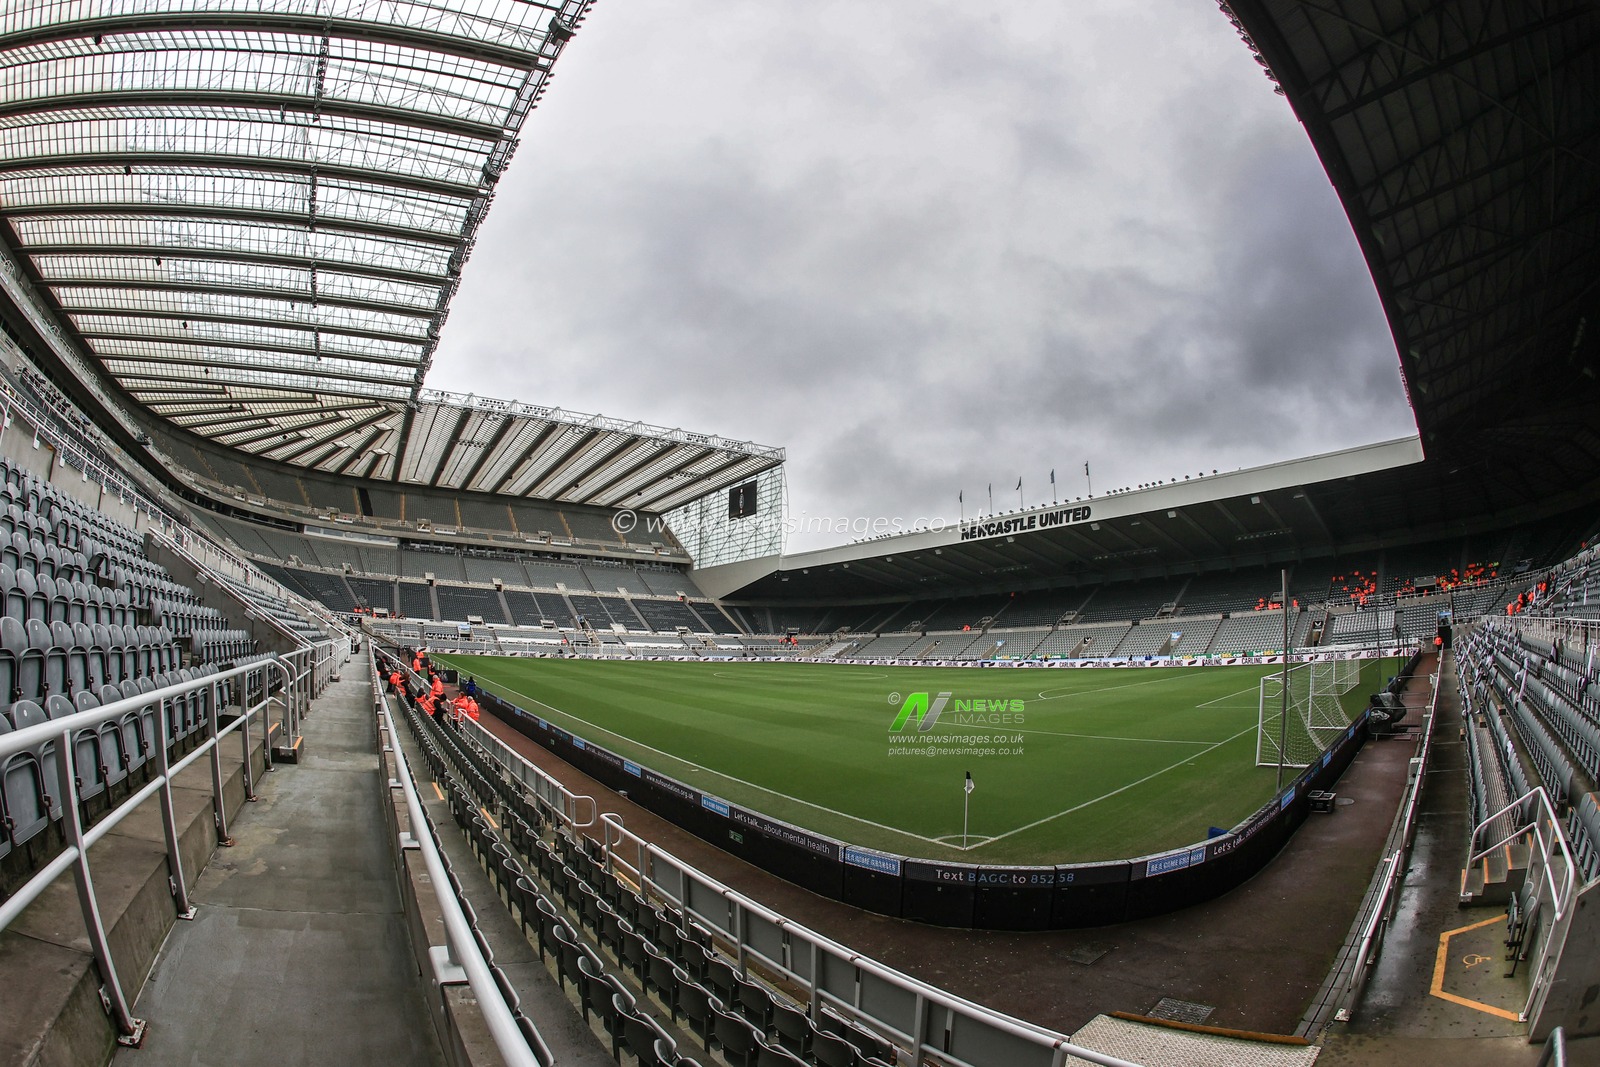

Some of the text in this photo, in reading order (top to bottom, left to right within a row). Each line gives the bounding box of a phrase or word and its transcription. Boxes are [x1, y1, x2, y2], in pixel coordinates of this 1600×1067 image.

[961, 506, 1092, 541] NEWCASTLE UNITED
[734, 811, 747, 823] Let's
[764, 824, 782, 837] about
[783, 831, 806, 846] mental
[807, 838, 830, 854] health
[1213, 842, 1231, 855] Let's
[935, 869, 1075, 884] Text BAGC to 85258
